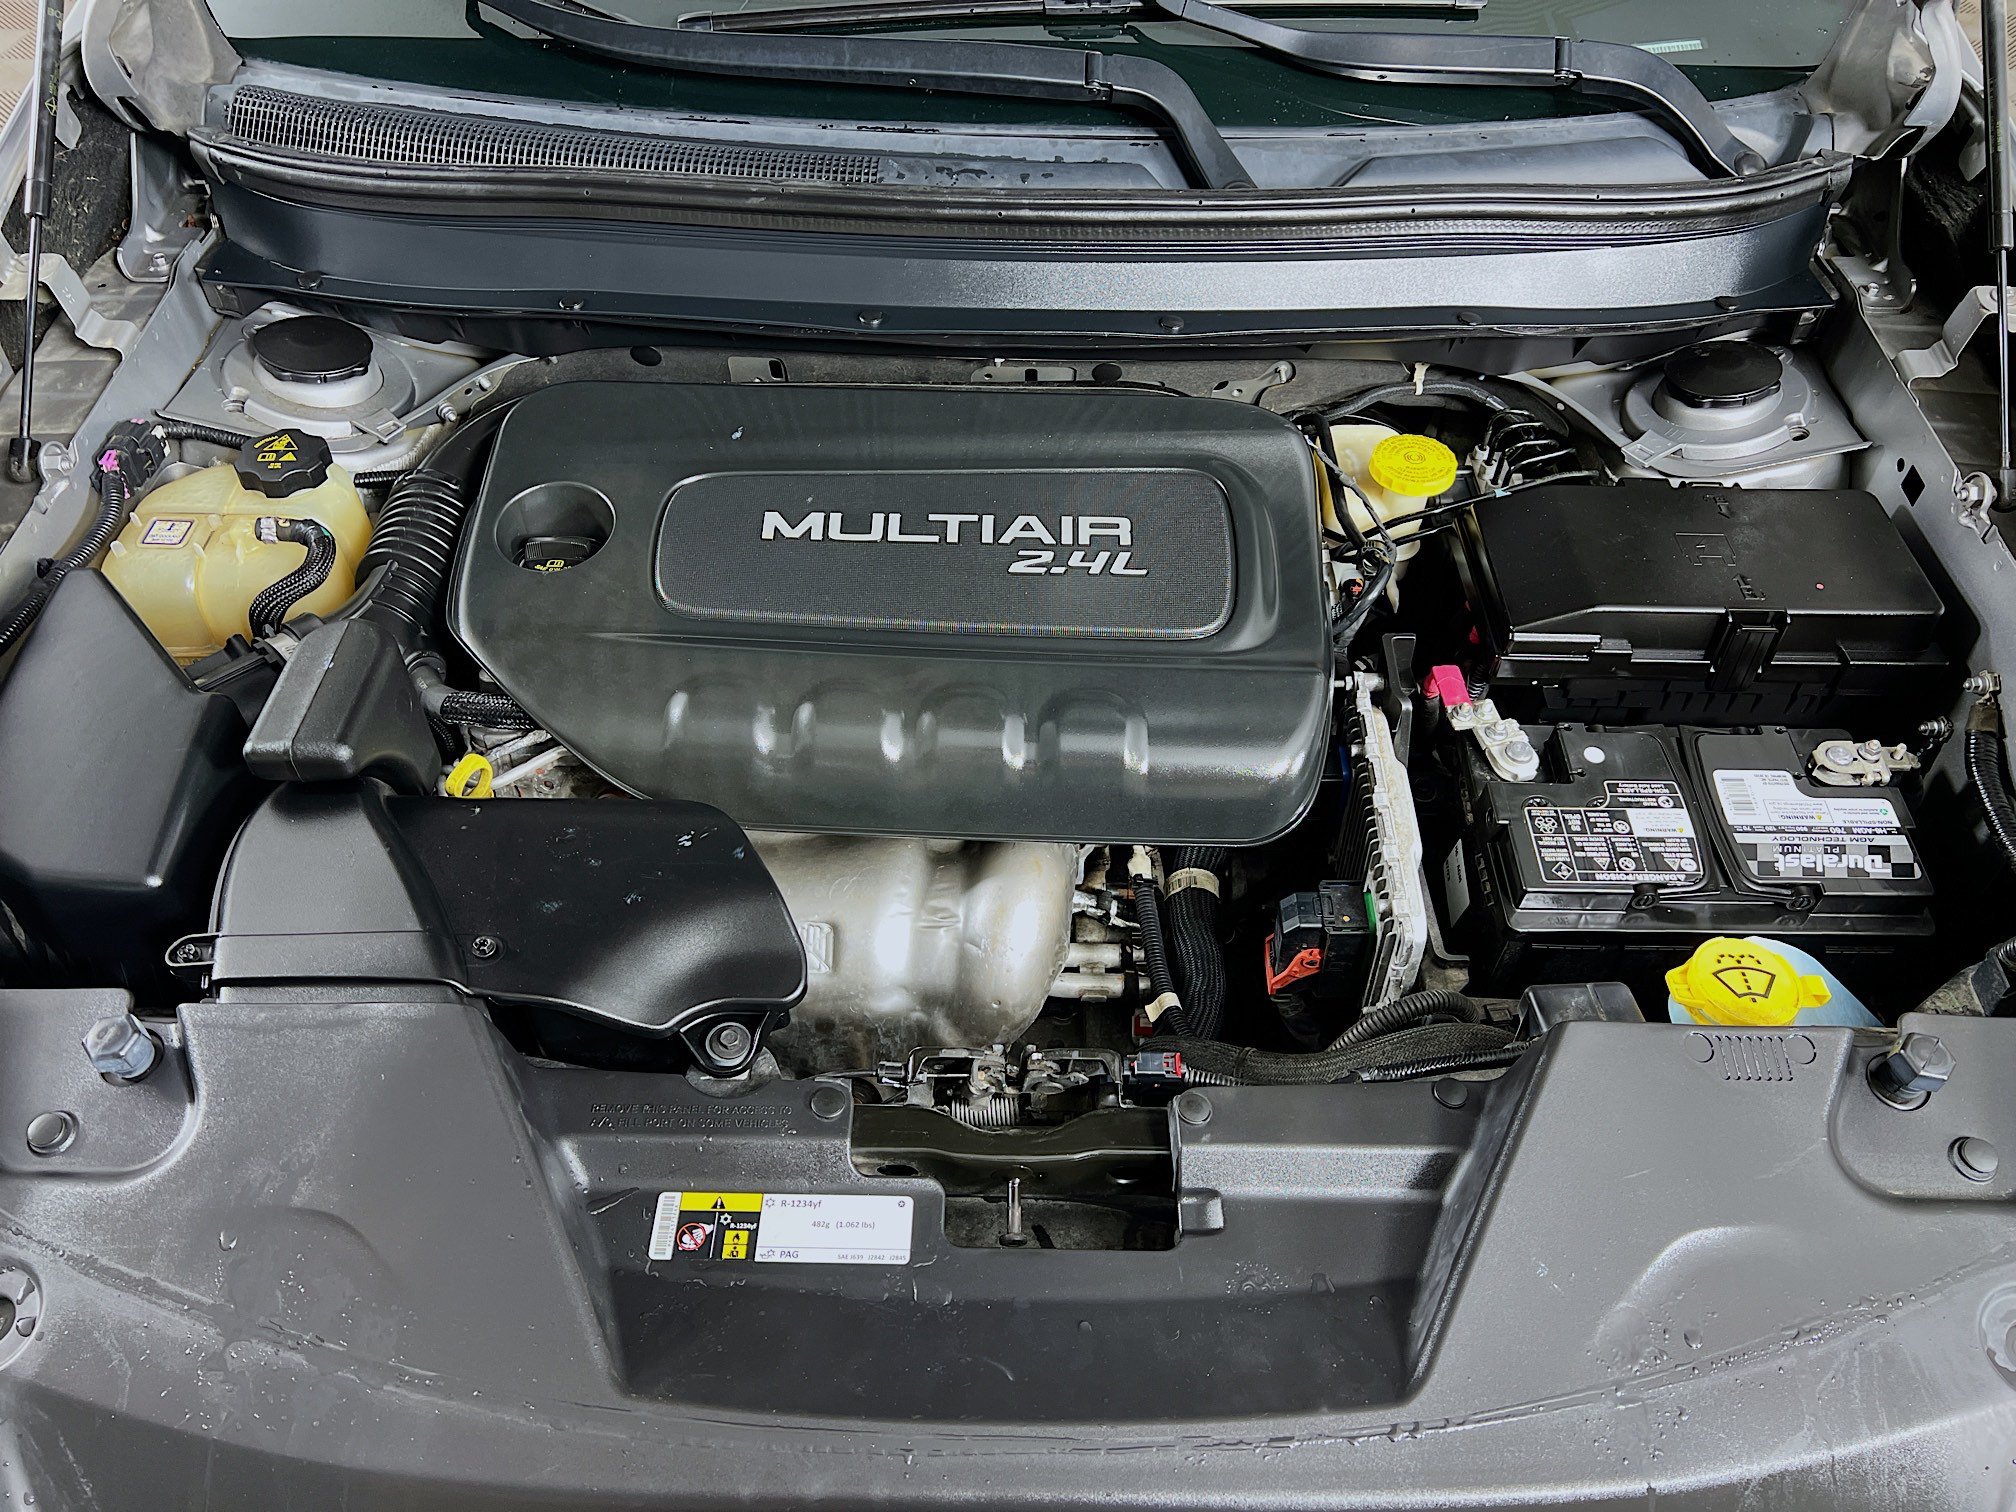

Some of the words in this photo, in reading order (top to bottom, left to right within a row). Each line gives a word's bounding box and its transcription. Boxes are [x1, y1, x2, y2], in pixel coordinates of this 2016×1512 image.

[760, 510, 1133, 547] MULTIAIR
[1007, 549, 1148, 577] 2.4L
[1771, 835, 1846, 843] TECHNOLOGY
[1771, 845, 1840, 854] PLATINUM
[1773, 853, 1892, 874] Duralast
[591, 1104, 639, 1113] REMOVE
[707, 1105, 729, 1115] FOR
[779, 1105, 793, 1115] TO
[678, 1118, 696, 1128] ON
[780, 1199, 822, 1210] R-1234yf
[729, 1223, 758, 1231] R-1234yf
[811, 1220, 830, 1229] 482g
[836, 1221, 860, 1229] (1.062
[861, 1221, 876, 1230] lbs)
[779, 1250, 799, 1259] PAG
